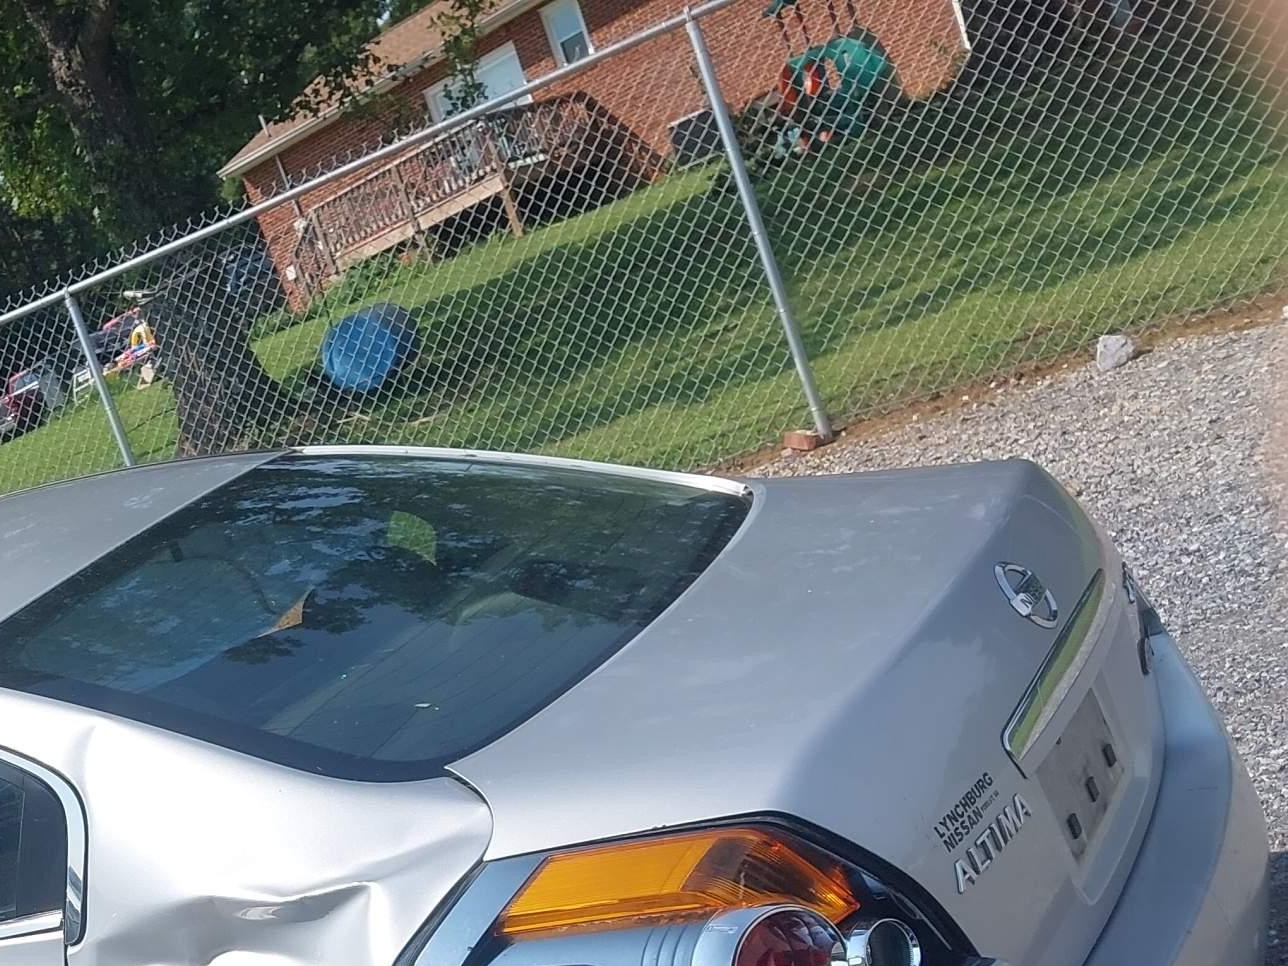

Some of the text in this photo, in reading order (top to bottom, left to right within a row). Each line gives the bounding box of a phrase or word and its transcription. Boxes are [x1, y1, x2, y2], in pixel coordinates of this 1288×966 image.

[933, 771, 993, 839] LYNCHBURG
[942, 805, 983, 853] NISSAN
[954, 793, 1032, 895] ALTIMA
